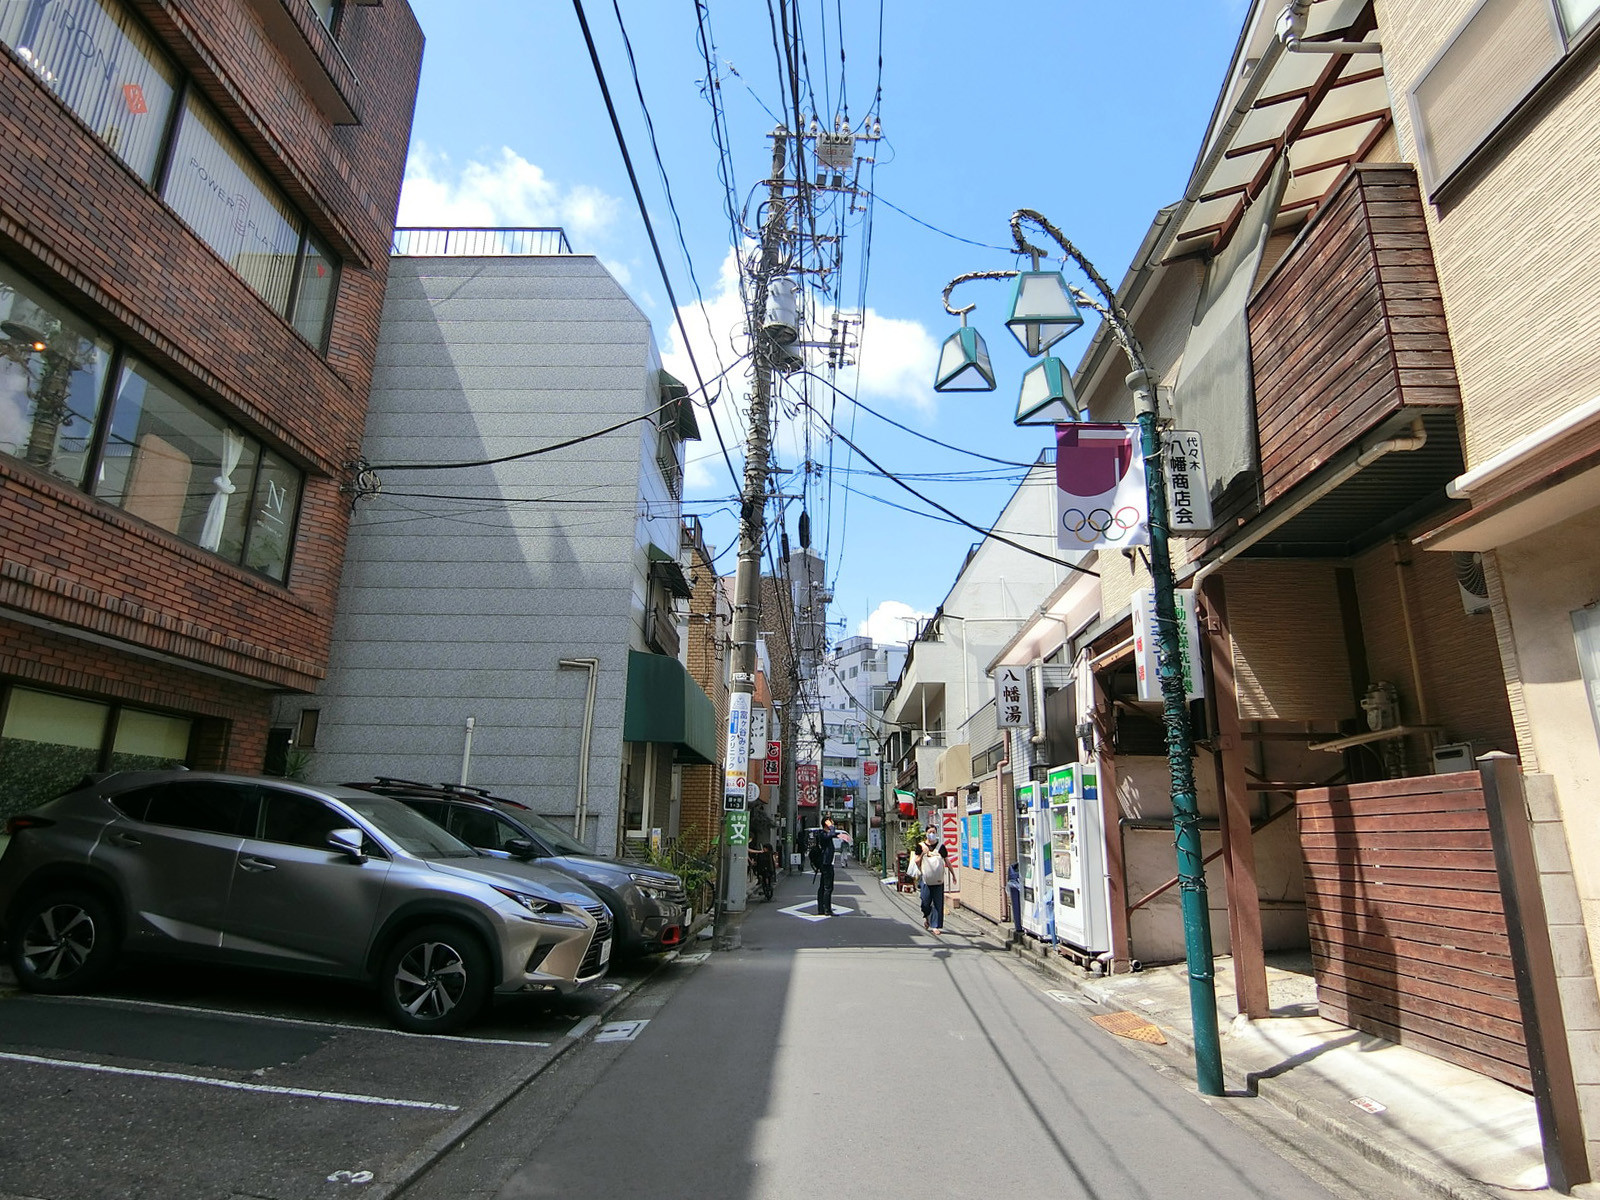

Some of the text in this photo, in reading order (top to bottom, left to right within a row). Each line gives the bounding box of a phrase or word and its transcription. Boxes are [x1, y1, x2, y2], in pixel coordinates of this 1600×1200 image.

[190, 157, 235, 210] POWER
[1186, 436, 1201, 471] 代々木
[265, 479, 287, 514] N
[1170, 440, 1194, 524] 八幡商店会
[1002, 669, 1022, 723] 八幡湯
[730, 822, 746, 840] 文
[942, 812, 959, 869] KIRIN
